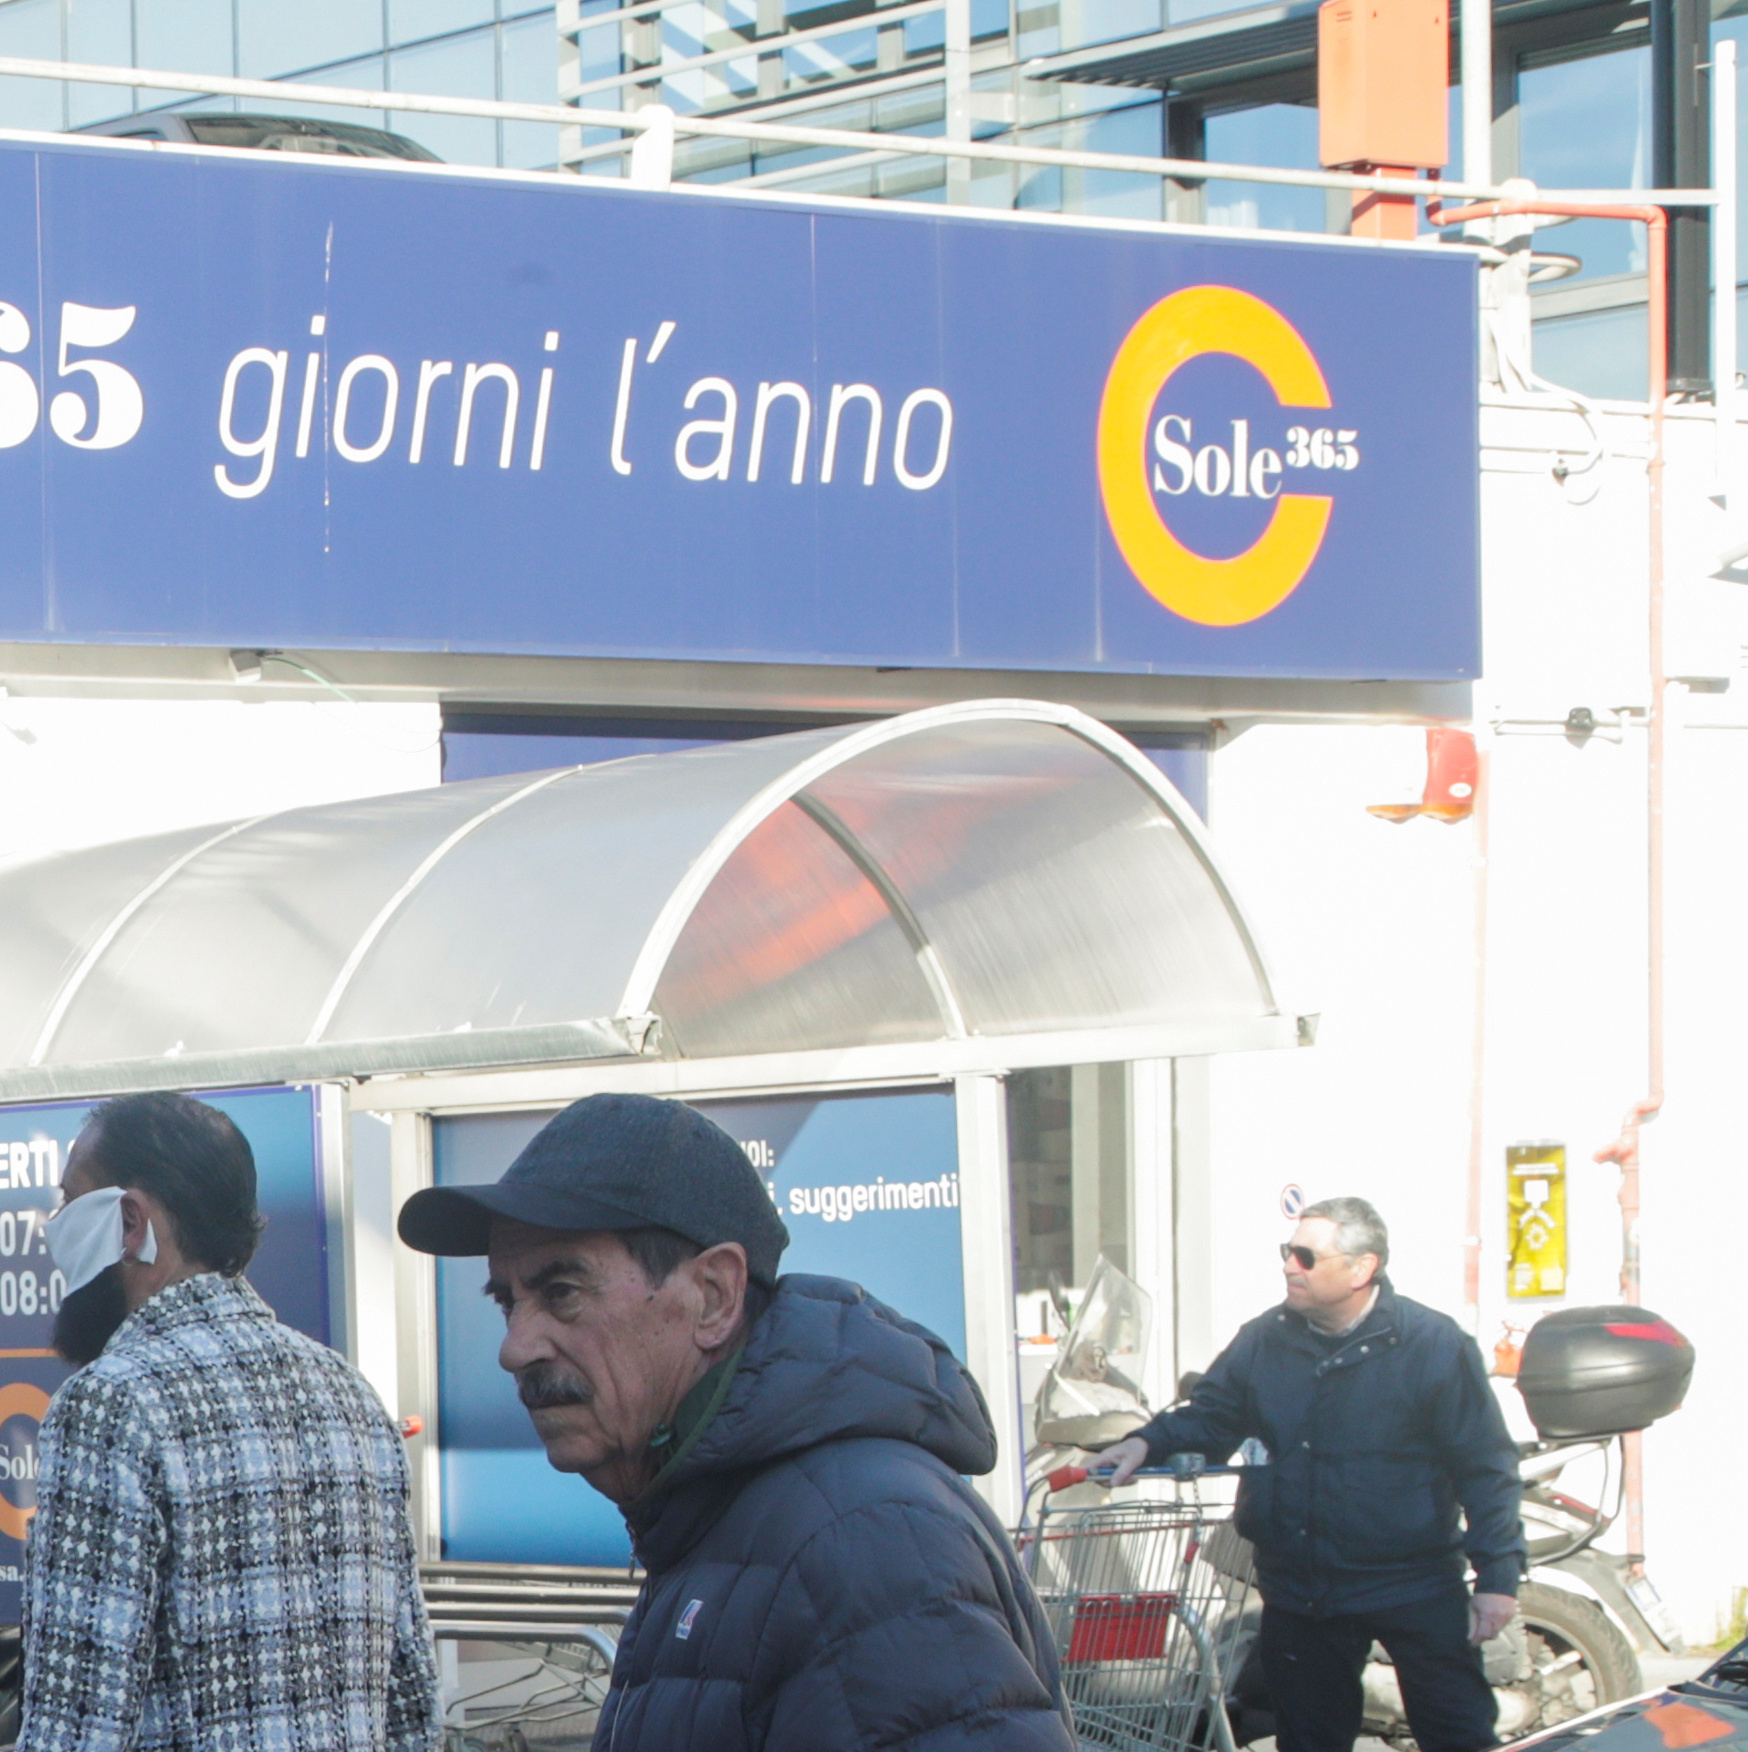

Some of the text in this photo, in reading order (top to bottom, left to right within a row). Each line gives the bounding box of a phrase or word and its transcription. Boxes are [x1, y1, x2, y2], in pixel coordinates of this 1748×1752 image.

[215, 314, 560, 500] giorni
[789, 1172, 959, 1222] suggerimenti
[0, 1268, 67, 1316] 08:0
